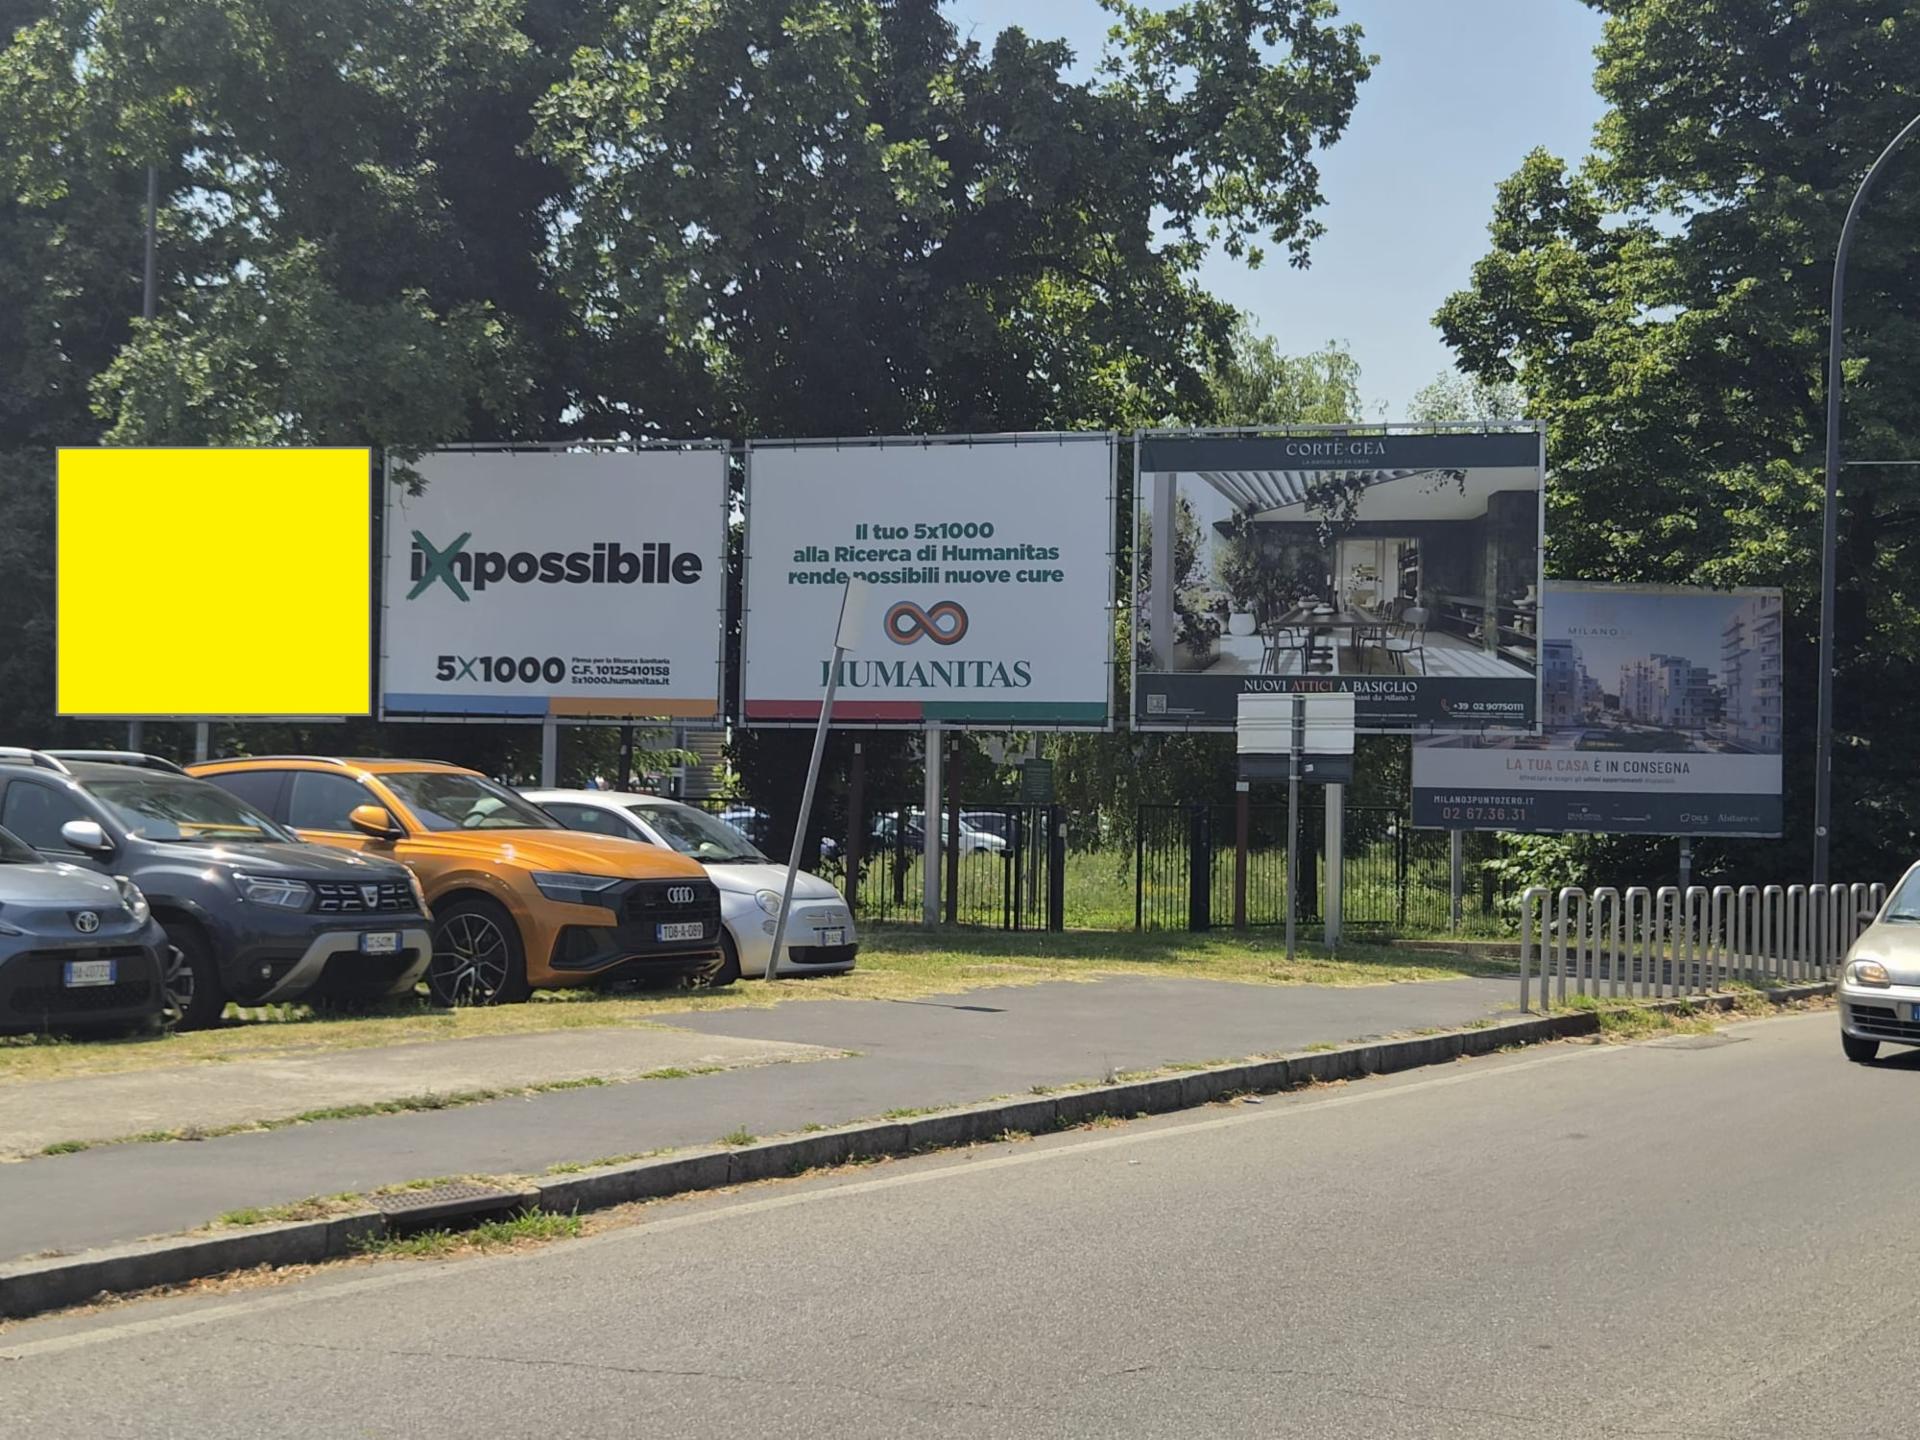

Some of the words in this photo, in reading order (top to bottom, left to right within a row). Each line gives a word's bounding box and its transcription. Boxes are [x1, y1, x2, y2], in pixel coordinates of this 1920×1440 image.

[856, 523, 868, 540] Il
[873, 524, 909, 540] tuo
[914, 522, 995, 540] 5x1000
[793, 546, 830, 562] alla
[835, 545, 912, 562] Ricerca
[917, 544, 937, 561] di
[942, 543, 1060, 561] Humanitas
[788, 567, 849, 585] rende
[944, 568, 1011, 583] nuove
[1015, 568, 1064, 583] cure
[571, 665, 594, 676] C.F.
[596, 665, 670, 677] 10125410158
[1244, 680, 1287, 692] NUOVI
[1291, 681, 1334, 692] ATTICI
[1338, 681, 1348, 693] A
[1353, 681, 1418, 693] BASIGLIO
[1453, 702, 1469, 710] +39
[1472, 703, 1485, 711] 02
[1506, 757, 1522, 770] LA
[1527, 758, 1553, 771] TUA
[1556, 759, 1590, 772] CASA
[1606, 760, 1619, 773] IN
[1623, 760, 1690, 774] CONSEGNA
[1442, 807, 1460, 819] 02
